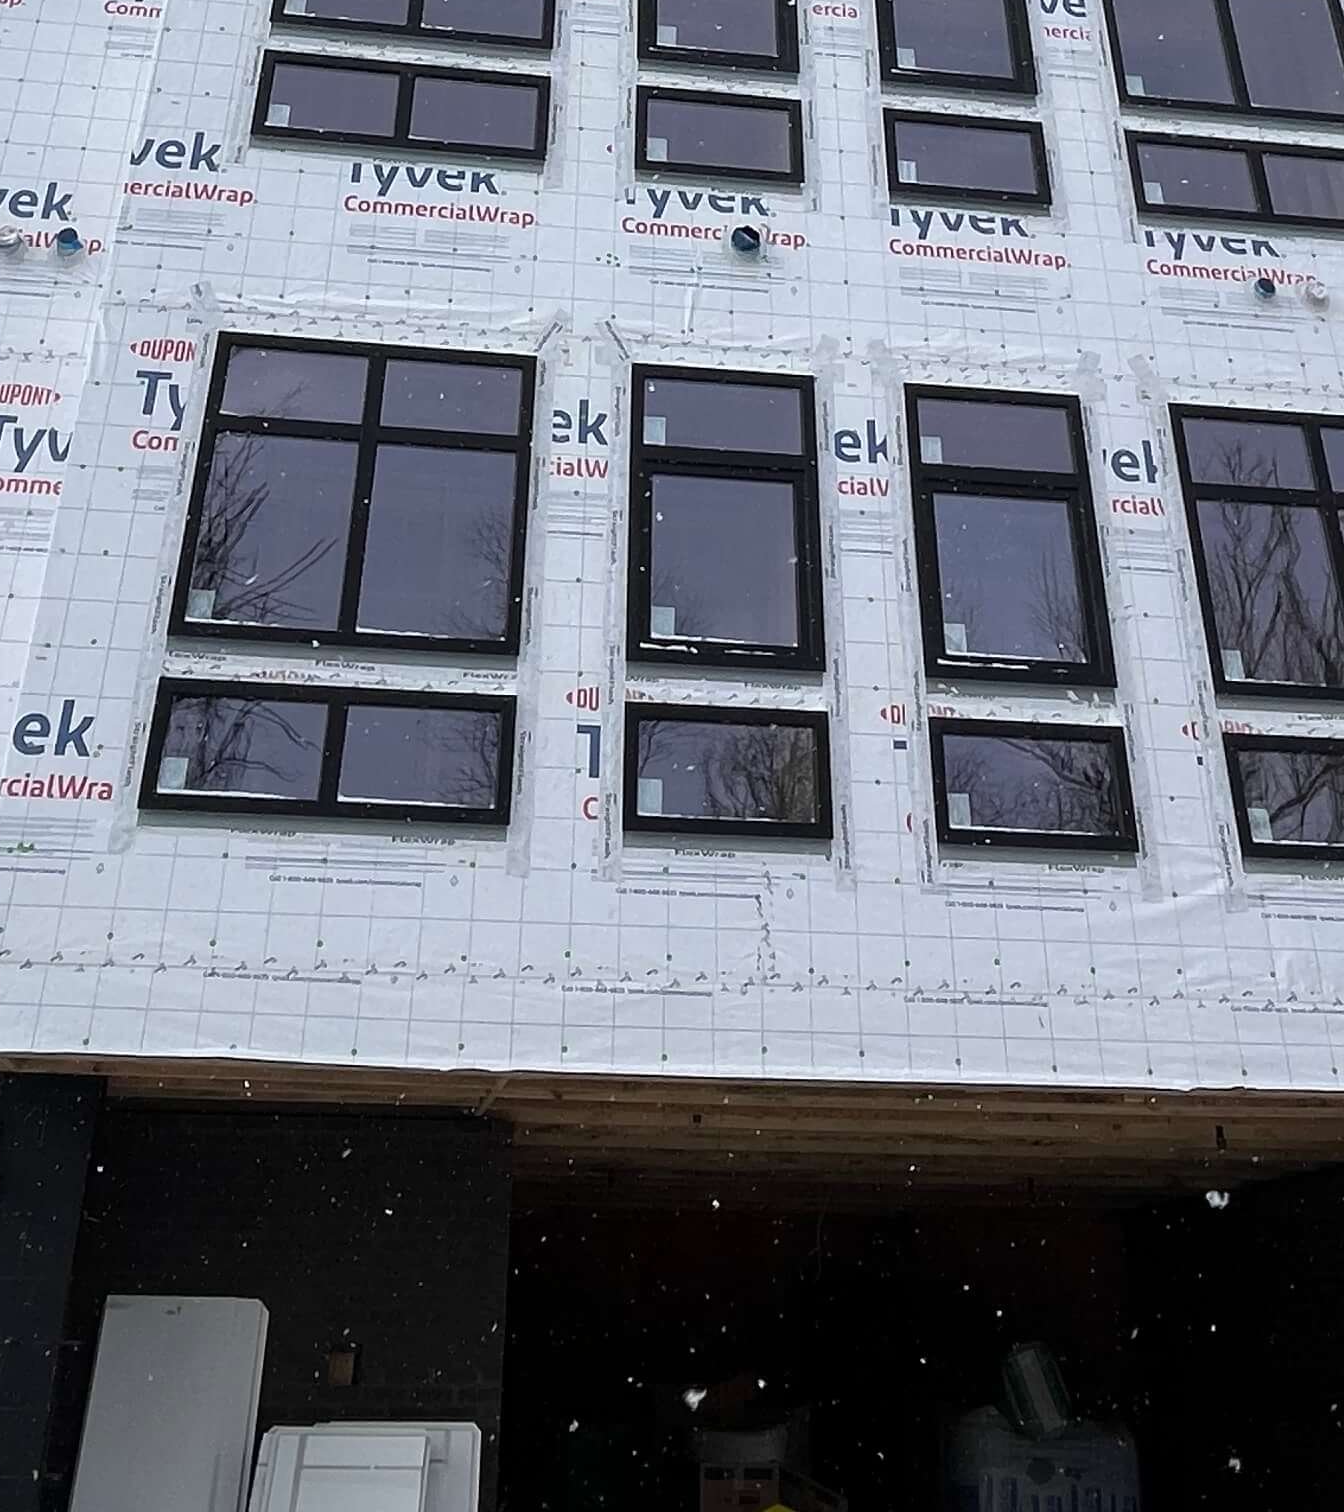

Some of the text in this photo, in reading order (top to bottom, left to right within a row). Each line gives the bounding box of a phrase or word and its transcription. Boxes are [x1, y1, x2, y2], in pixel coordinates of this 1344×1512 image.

[344, 195, 534, 228] CommercialWrap
[889, 238, 1068, 270] CommercialWrap
[136, 340, 195, 362] DUPON
